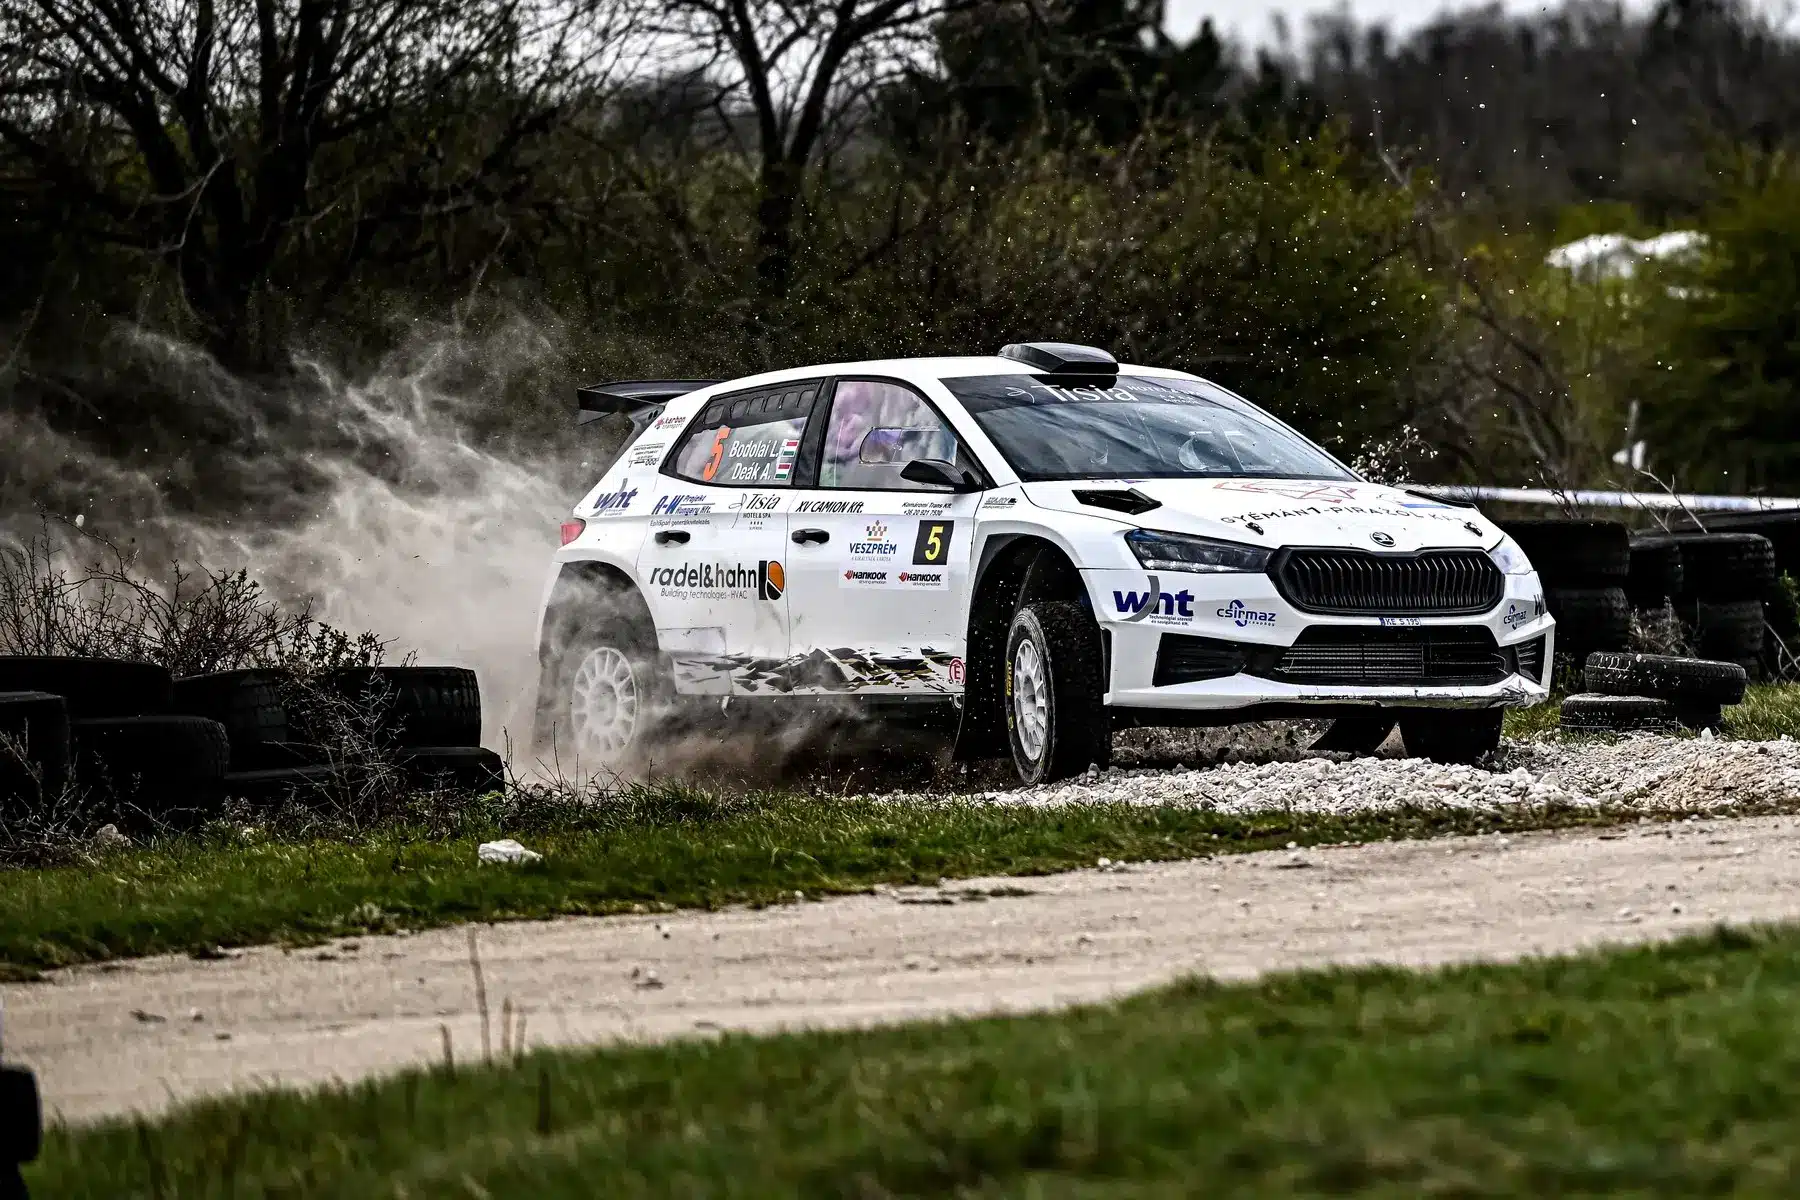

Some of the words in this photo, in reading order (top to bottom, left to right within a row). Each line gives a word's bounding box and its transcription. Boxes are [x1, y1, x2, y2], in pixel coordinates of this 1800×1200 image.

[1030, 385, 1139, 401] Tisia
[703, 427, 732, 481] 5
[729, 439, 770, 458] Bodolai
[732, 461, 760, 480] Deák
[760, 462, 771, 480] A.
[651, 495, 685, 515] A-W
[746, 493, 781, 510] Tisia
[795, 500, 813, 513] XV
[811, 500, 850, 513] CAMION
[849, 540, 897, 555] VESZPRÉM
[924, 526, 944, 560] 5
[650, 562, 757, 588] radel&hahn
[661, 588, 688, 600] Building
[689, 590, 727, 601] technologies
[731, 590, 748, 599] HVAC
[1216, 607, 1276, 622] csirmaz
